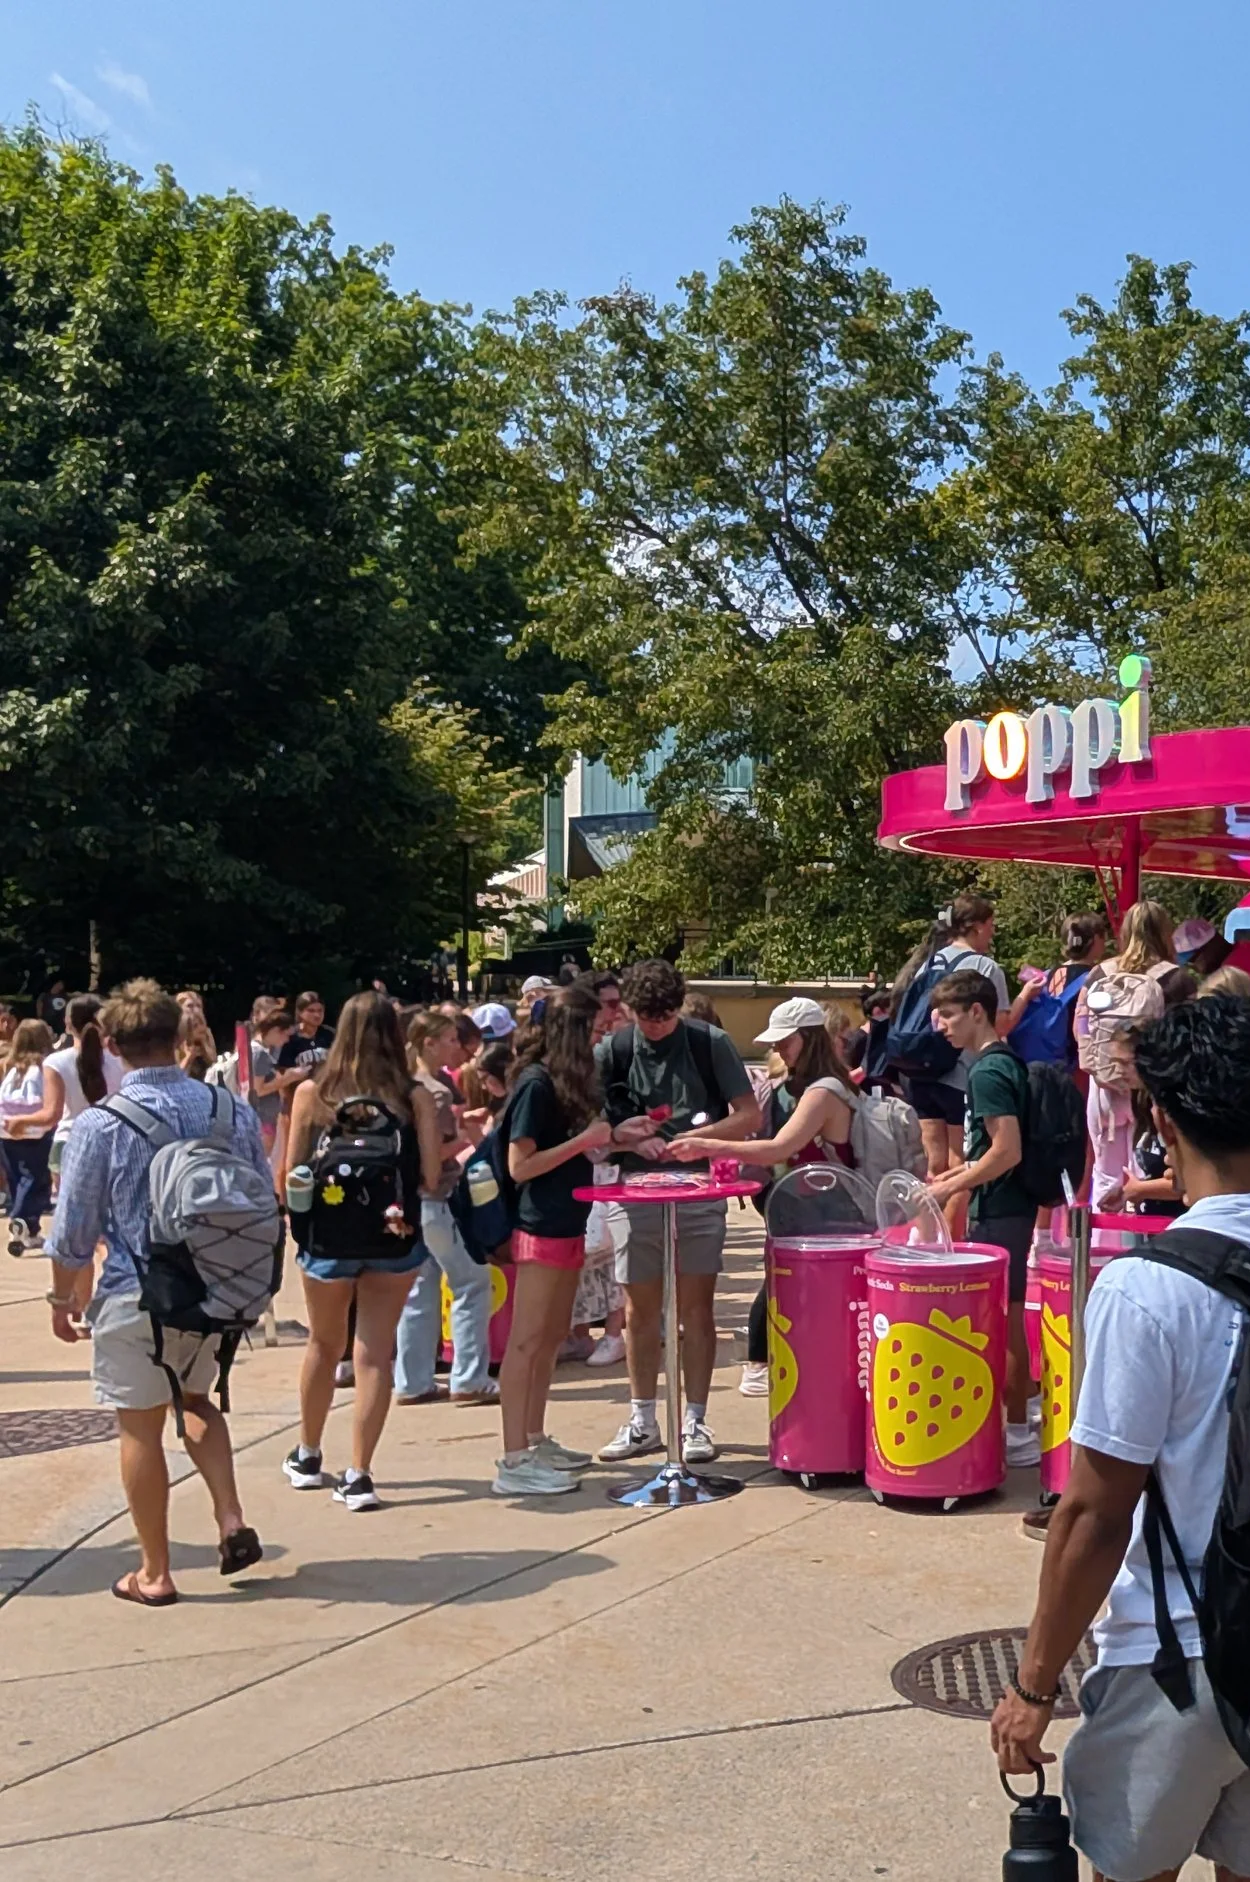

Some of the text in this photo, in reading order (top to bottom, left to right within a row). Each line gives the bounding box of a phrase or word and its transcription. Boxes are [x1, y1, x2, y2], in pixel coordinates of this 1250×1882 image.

[944, 655, 1152, 811] poppi
[899, 1282, 990, 1294] Strawberry Lemon
